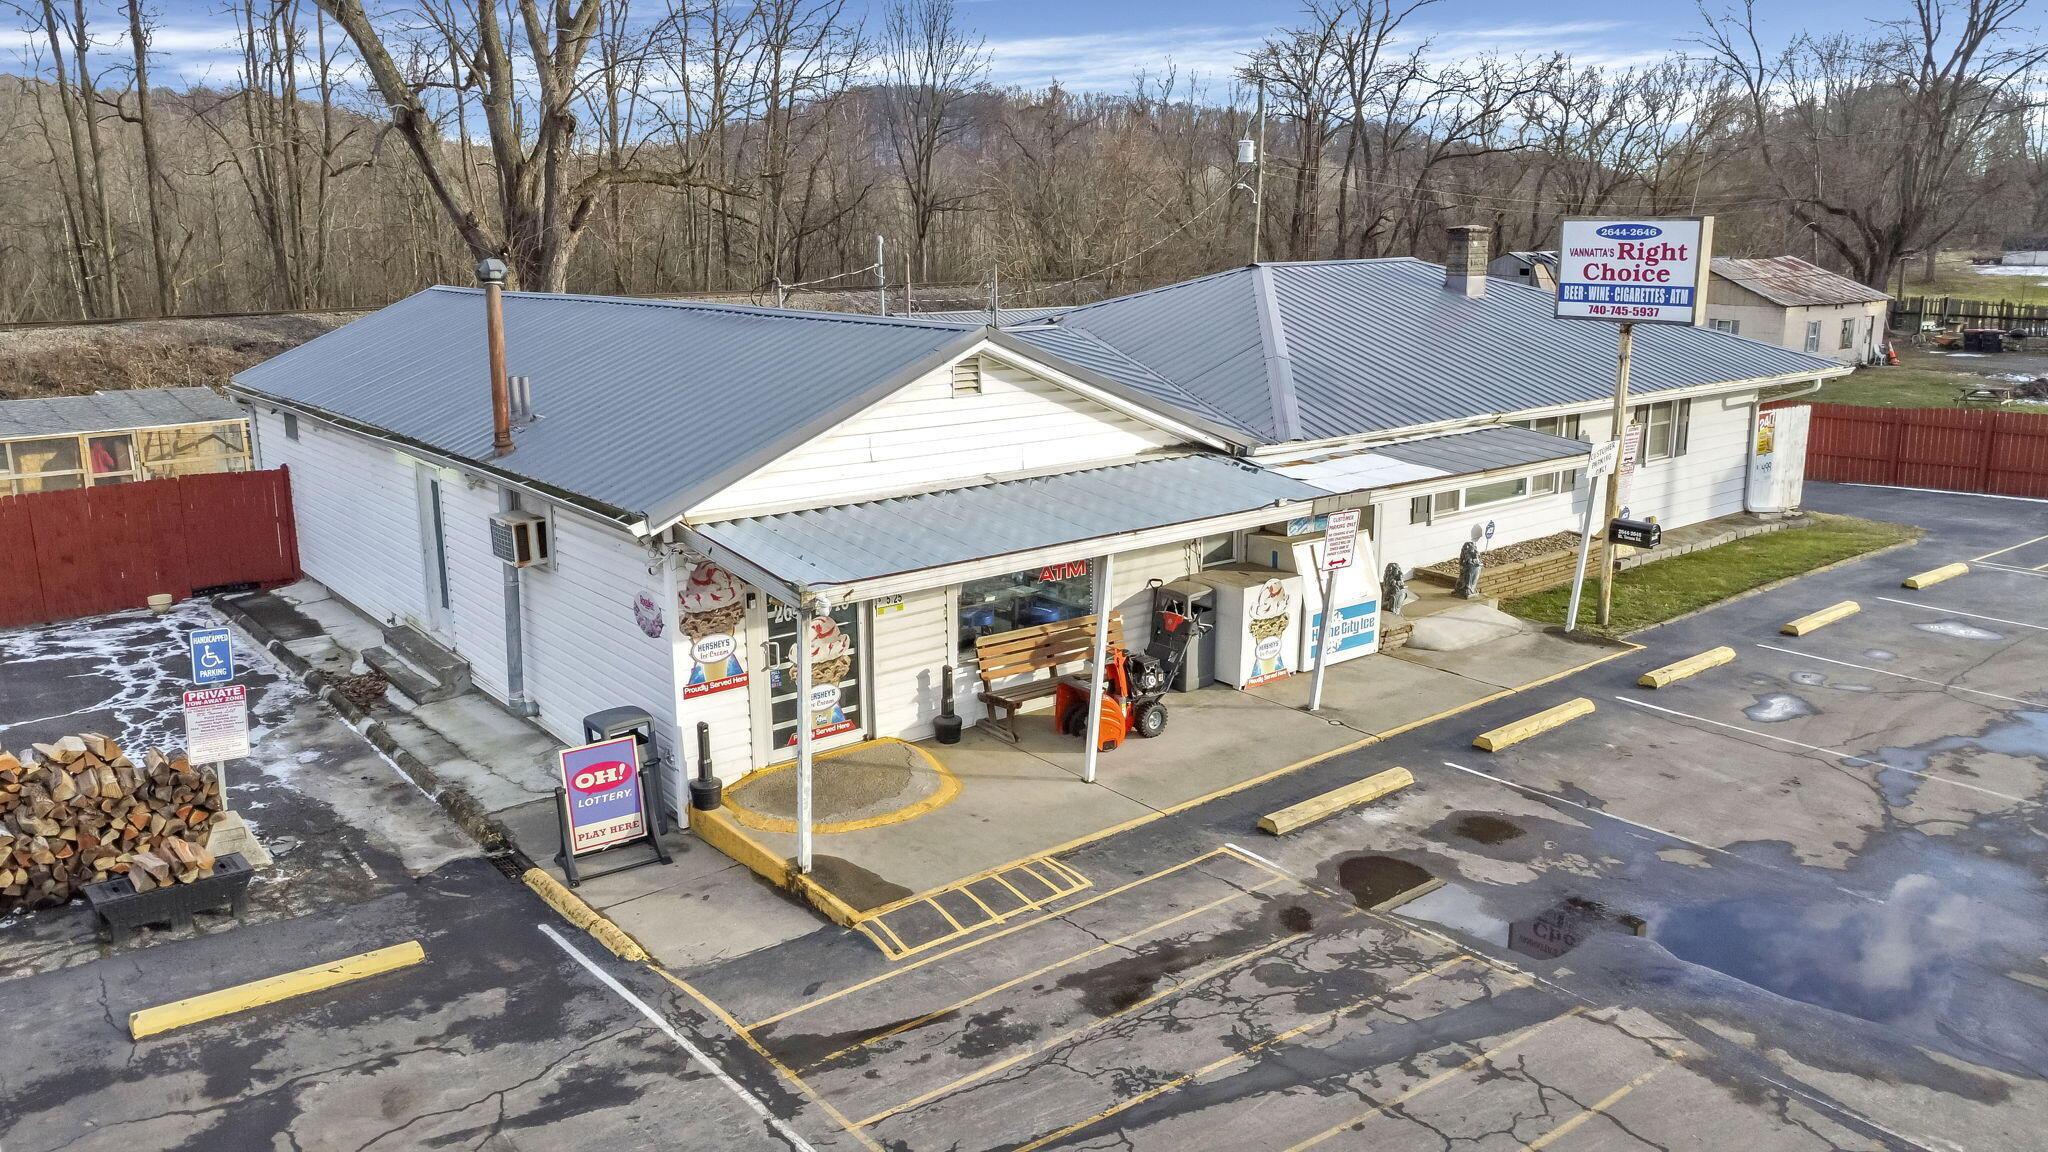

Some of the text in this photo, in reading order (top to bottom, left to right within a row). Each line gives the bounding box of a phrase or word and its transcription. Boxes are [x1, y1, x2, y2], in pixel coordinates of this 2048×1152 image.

[1601, 228, 1657, 237] 2644-2646
[1569, 242, 1688, 266] VANNATTA'S Right
[1583, 263, 1671, 283] Choice
[1564, 285, 1689, 305] BEER WINE CIGARETTES ATM
[1588, 305, 1660, 317] 740-745-5937
[1333, 515, 1354, 523] CUSTOMER
[1038, 559, 1087, 584] ATM
[1341, 620, 1360, 635] City
[1360, 617, 1375, 630] Ice
[193, 633, 229, 645] HANDICAPPED
[697, 638, 730, 652] HERSHEY'S
[709, 649, 730, 658] Cream
[200, 667, 227, 678] PARKING
[684, 675, 748, 695] Proudly Served Here
[186, 694, 245, 707] TOW-AWAY ZONE
[188, 687, 241, 702] PRIVATE
[811, 688, 836, 701] ERSHEY'S
[815, 725, 836, 735] Served
[837, 722, 851, 730] Here
[575, 763, 626, 789] OH!
[578, 820, 640, 842] PLAY HERE
